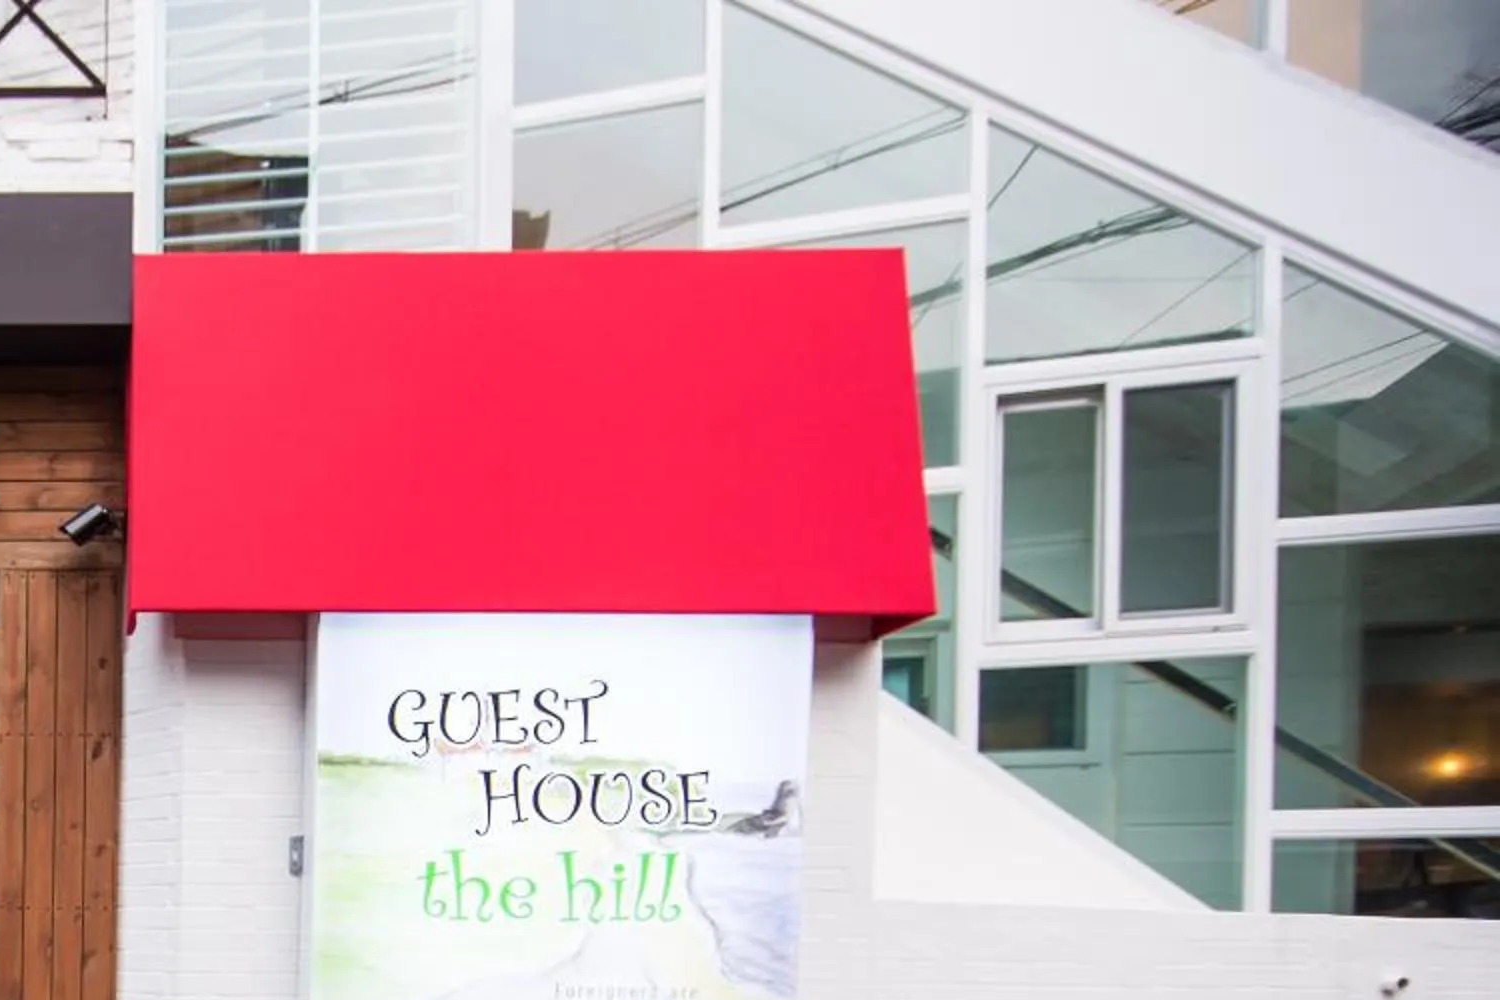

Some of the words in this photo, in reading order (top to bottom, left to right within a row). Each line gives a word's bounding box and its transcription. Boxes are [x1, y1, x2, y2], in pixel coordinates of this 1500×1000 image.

[386, 679, 609, 758] GUEST
[474, 763, 719, 837] HOUSE
[416, 848, 537, 924] the
[557, 849, 682, 924] hill
